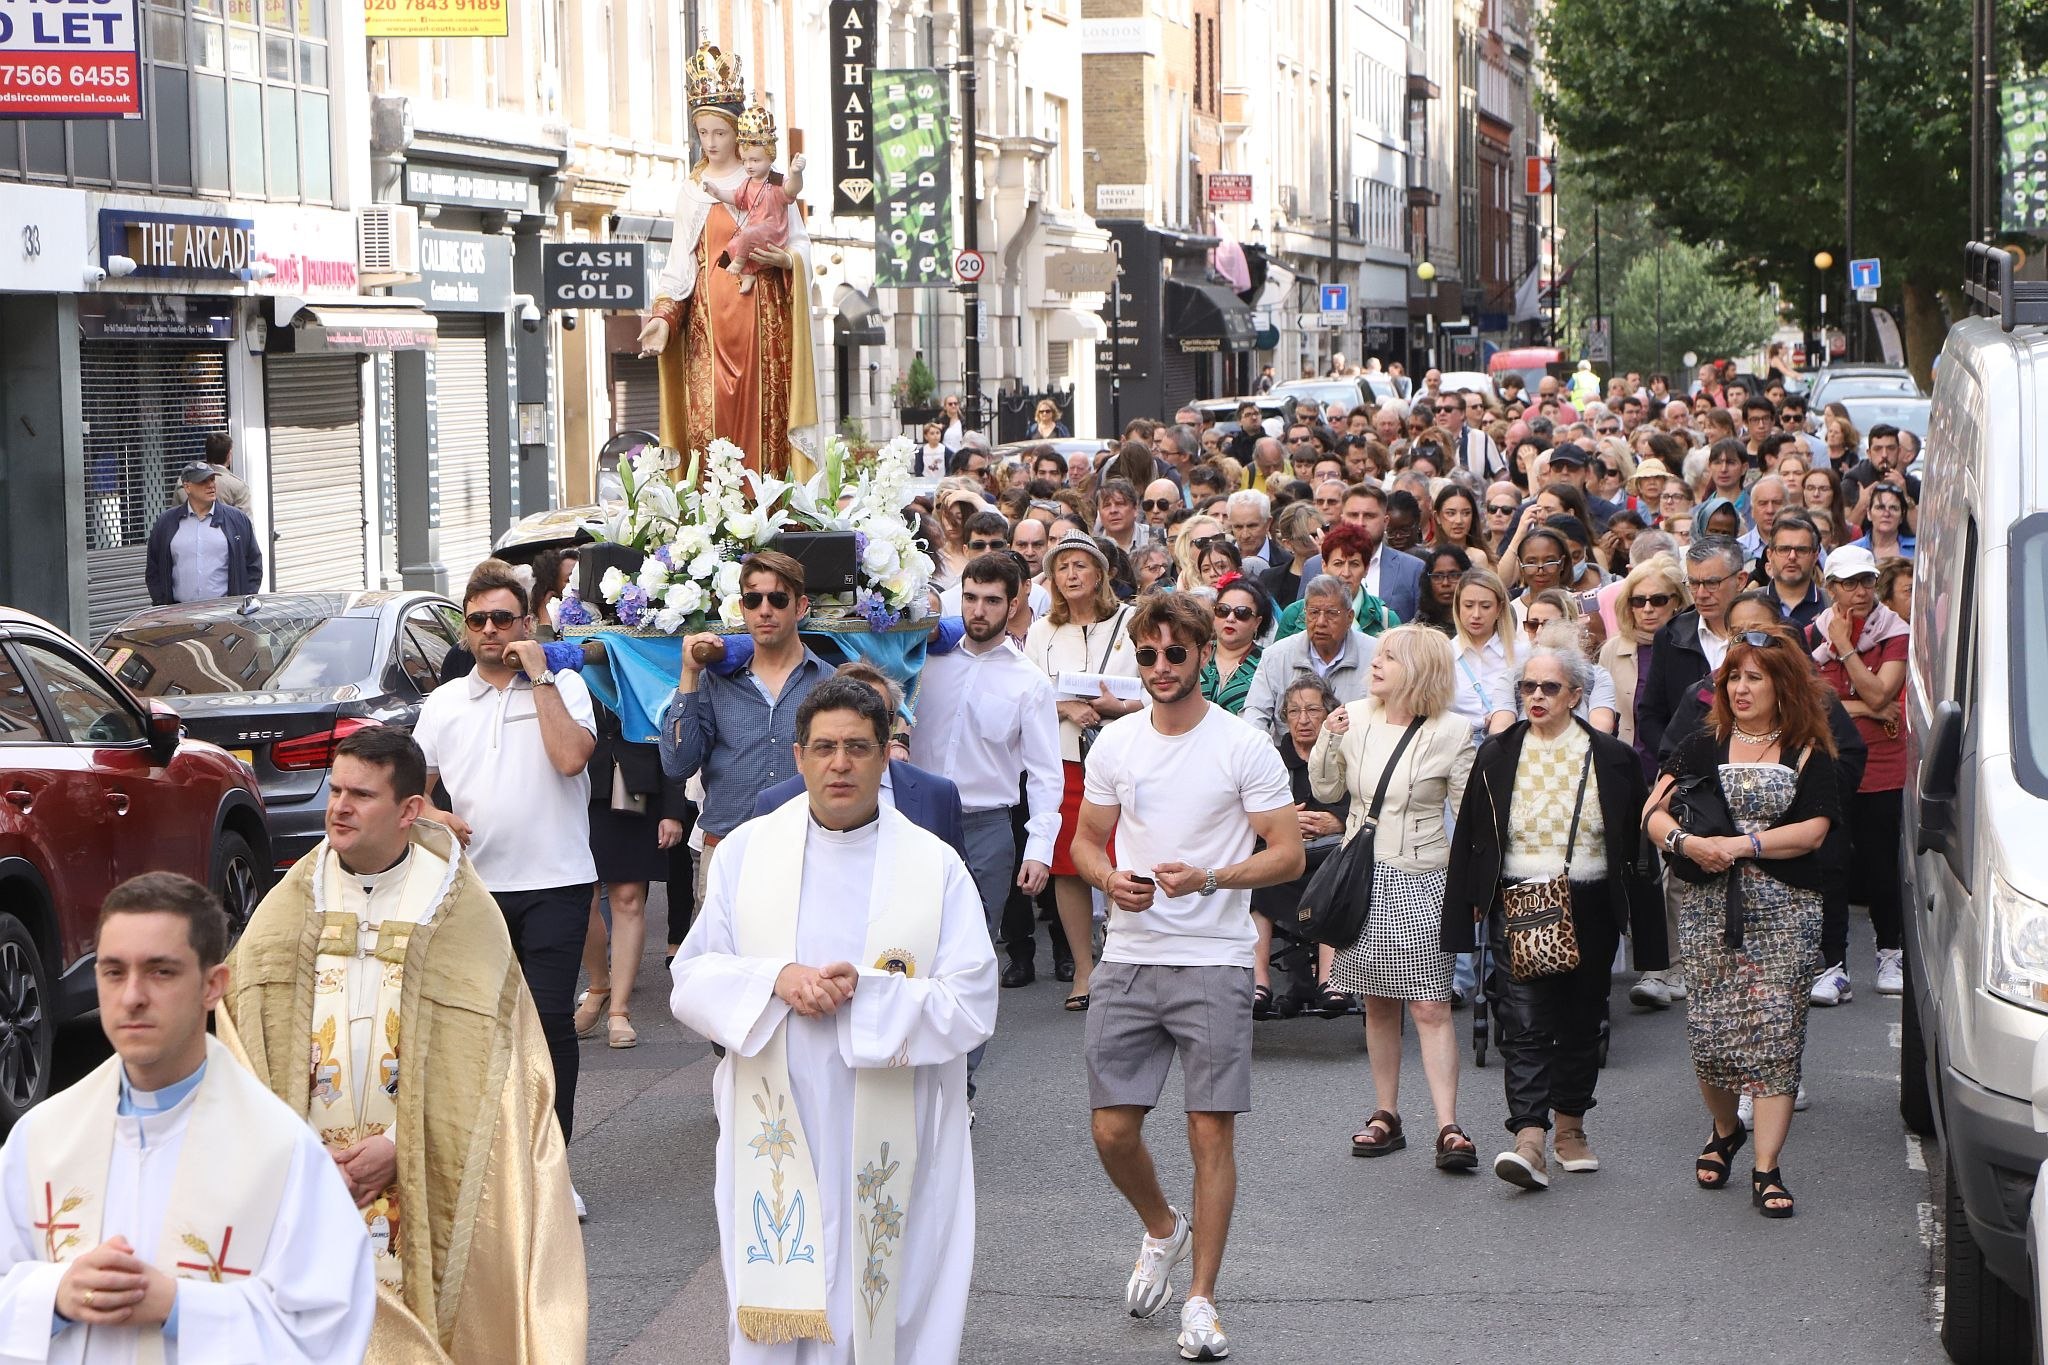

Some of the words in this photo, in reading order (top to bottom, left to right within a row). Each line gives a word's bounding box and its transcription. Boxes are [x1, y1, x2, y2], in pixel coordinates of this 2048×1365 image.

[32, 12, 123, 45] LET
[0, 65, 62, 86] 7566
[69, 65, 130, 86] 6455
[843, 8, 865, 169] APHAEL
[0, 93, 131, 103] dsircommercial.co.uk
[2014, 91, 2027, 219] JOHNSON
[2034, 89, 2047, 221] GARDENS
[889, 84, 908, 273] JOHNSON
[917, 84, 936, 273] GARDENS
[24, 224, 41, 257] 33
[139, 222, 177, 267] THE
[184, 224, 256, 272] ARCADE
[557, 251, 633, 267] CASH
[581, 269, 610, 281] for
[960, 260, 981, 271] 20
[557, 284, 633, 299] GOLD
